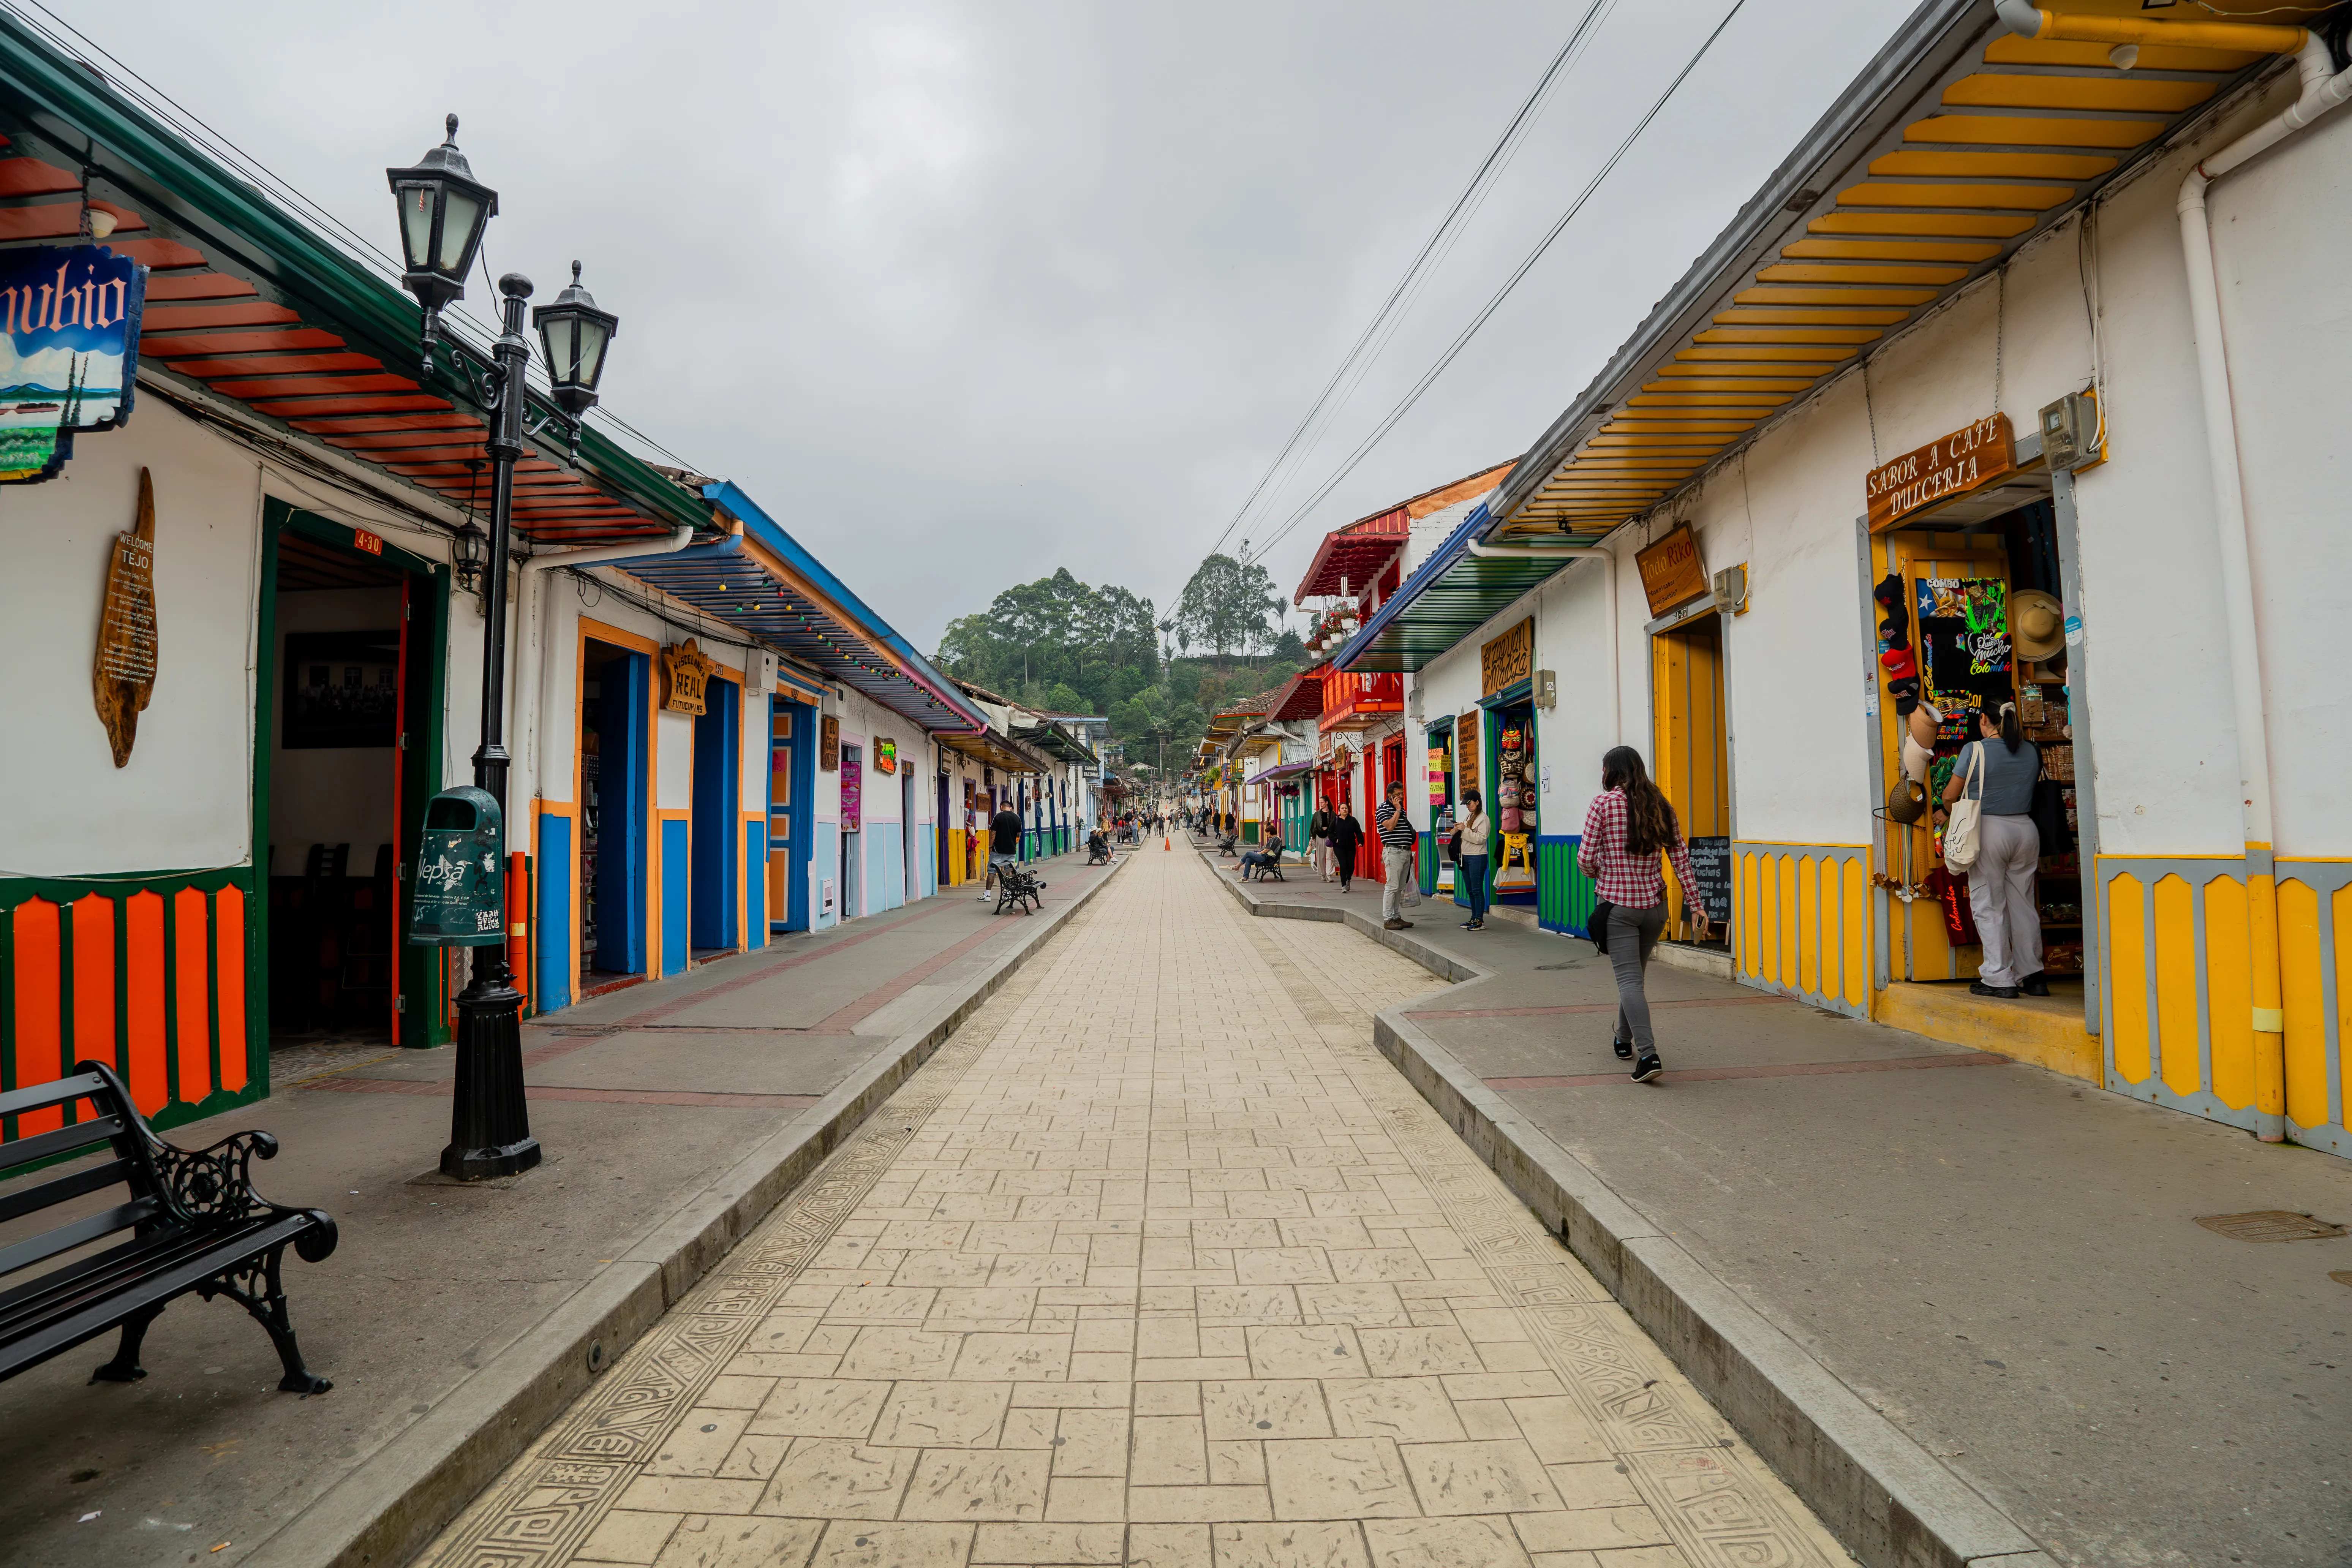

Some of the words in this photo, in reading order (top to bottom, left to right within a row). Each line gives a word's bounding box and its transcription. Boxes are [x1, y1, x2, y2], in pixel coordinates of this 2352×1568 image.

[1868, 456, 1918, 498] SABOR
[1928, 445, 1939, 469] A
[1950, 416, 1998, 458] CAFE
[1890, 457, 1978, 515] DULCERIA
[120, 533, 153, 553] WELCOME
[359, 533, 379, 552] 4-30
[122, 550, 148, 569] TEJO
[1642, 556, 1667, 583] Todo
[1667, 541, 1692, 567] Riko
[1663, 579, 1675, 590] sabor
[1927, 579, 1960, 588] COMBO
[1977, 637, 1999, 650] Quiero
[1484, 645, 1491, 672] El
[676, 672, 702, 700] REAL
[830, 721, 836, 735] EL
[1946, 885, 1962, 931] Colombia
